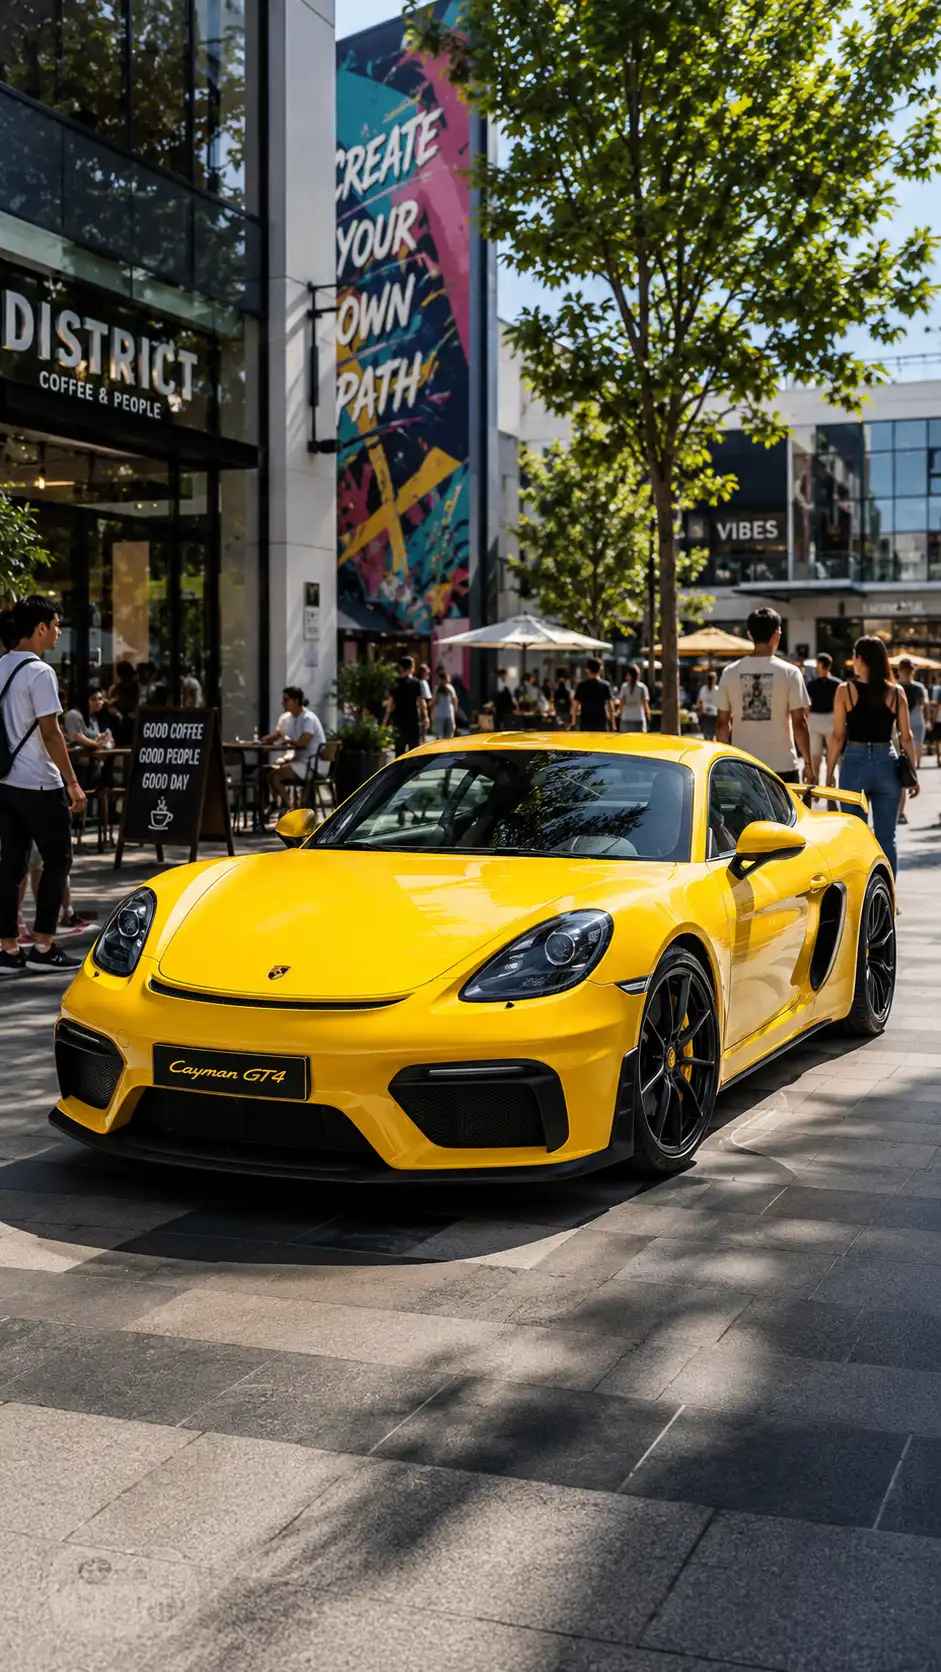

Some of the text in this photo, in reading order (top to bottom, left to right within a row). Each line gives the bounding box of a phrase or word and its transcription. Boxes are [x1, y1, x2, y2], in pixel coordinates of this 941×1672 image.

[336, 200, 418, 278] YOUR
[336, 272, 416, 345] OWN
[3, 289, 198, 401] DISTRICT
[39, 370, 162, 419] COFFEE & PEOPLE
[335, 350, 422, 425] PATH
[717, 520, 778, 541] VIBES
[143, 722, 204, 740] GOOD COFFEE
[139, 747, 201, 765] GOOD PEOPLE
[142, 772, 190, 791] GOOD DAY
[169, 1060, 287, 1084] Cayman GT4
